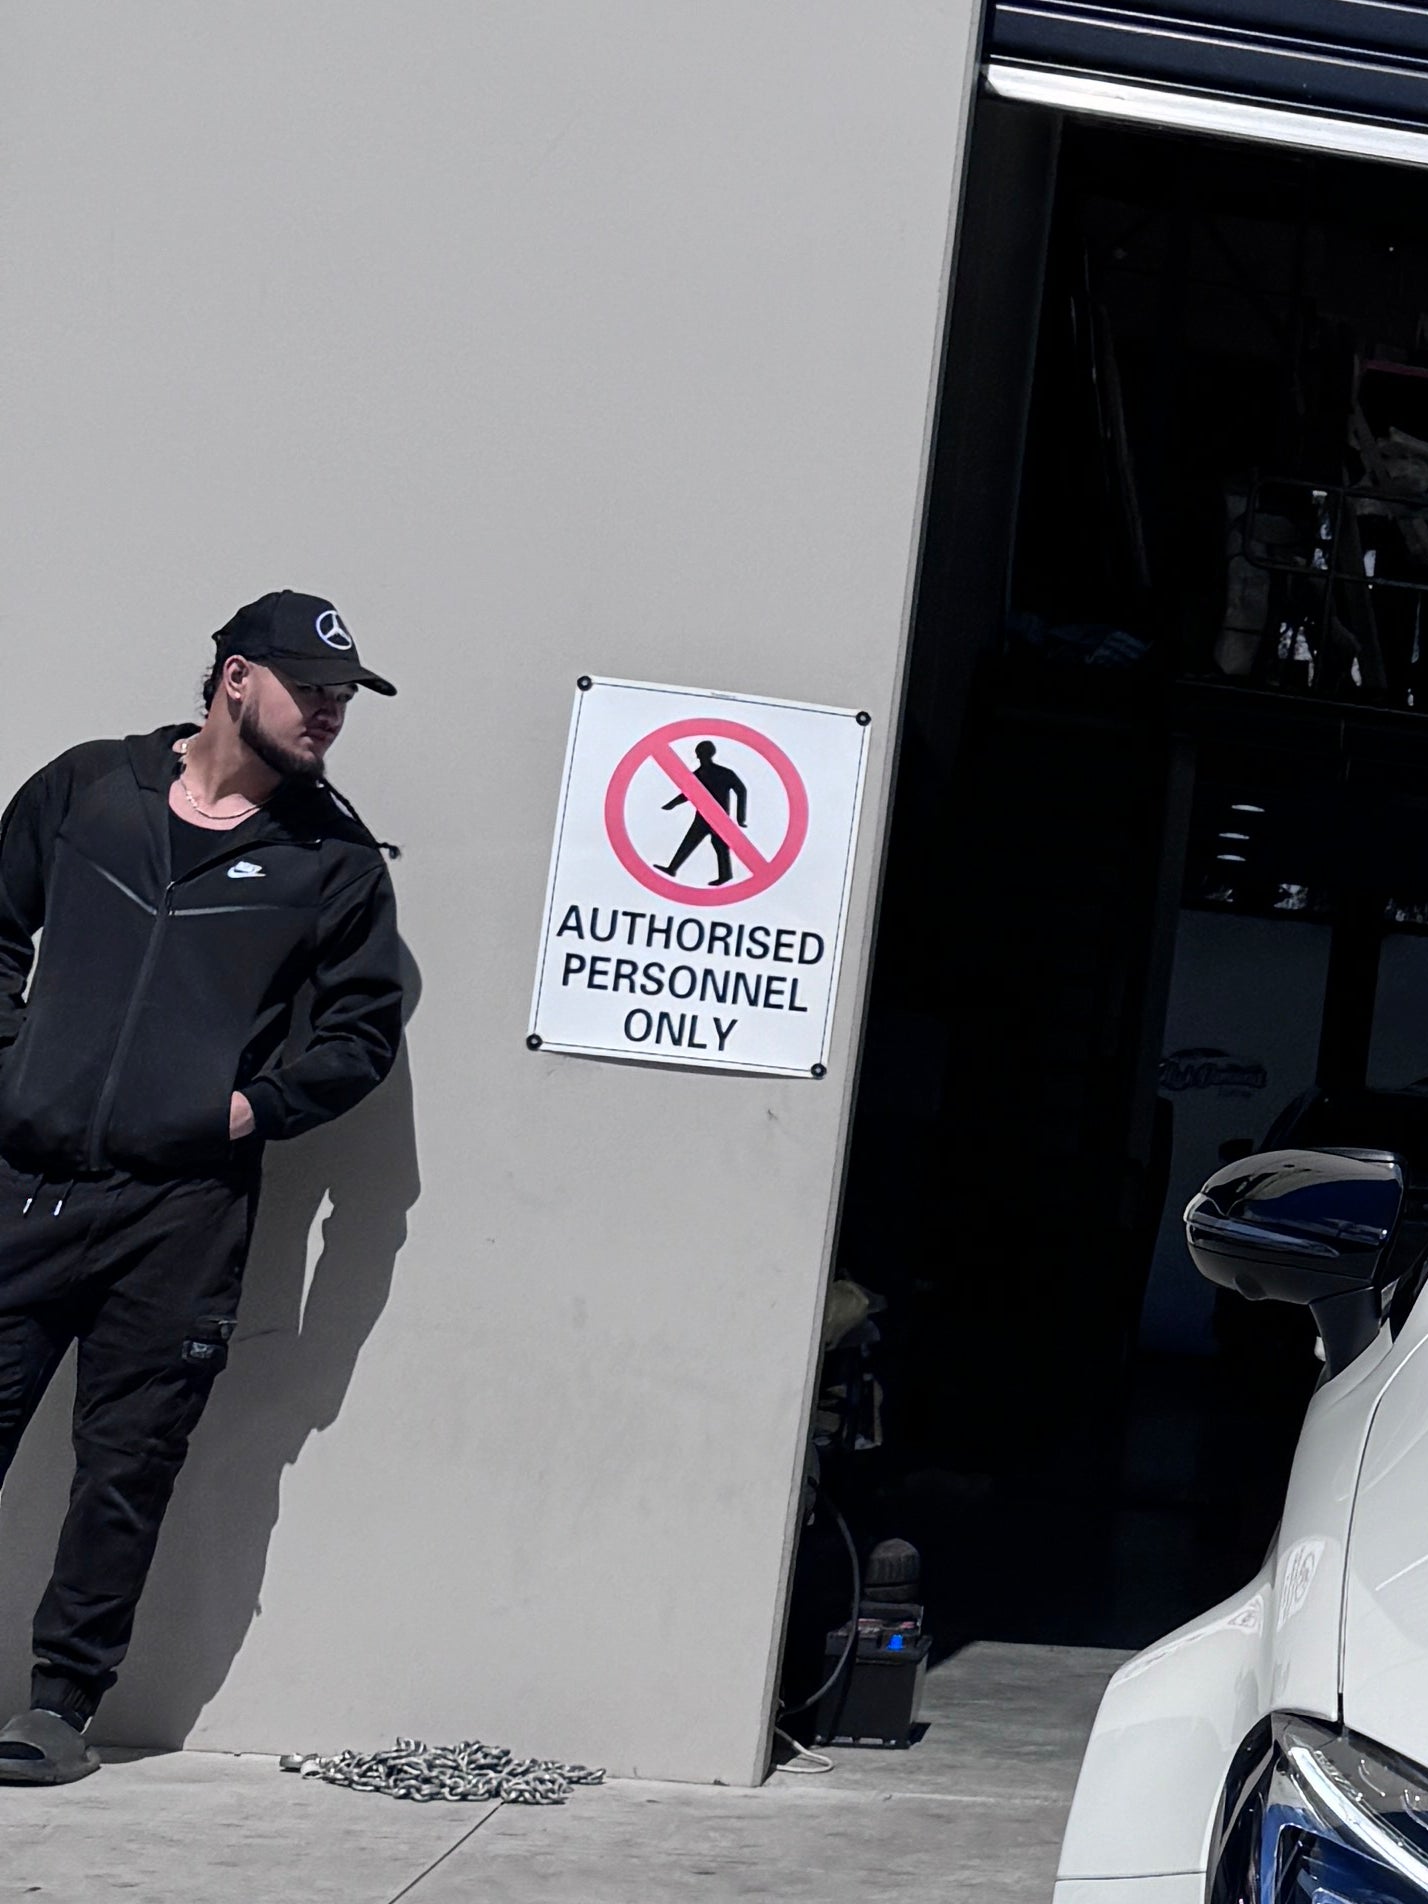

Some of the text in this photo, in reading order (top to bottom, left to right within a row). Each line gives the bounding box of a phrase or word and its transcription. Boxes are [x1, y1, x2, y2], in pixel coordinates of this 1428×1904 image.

[557, 904, 825, 966] AUTHORISED
[561, 953, 809, 1013] PERSONNEL
[623, 1007, 739, 1052] ONLY
